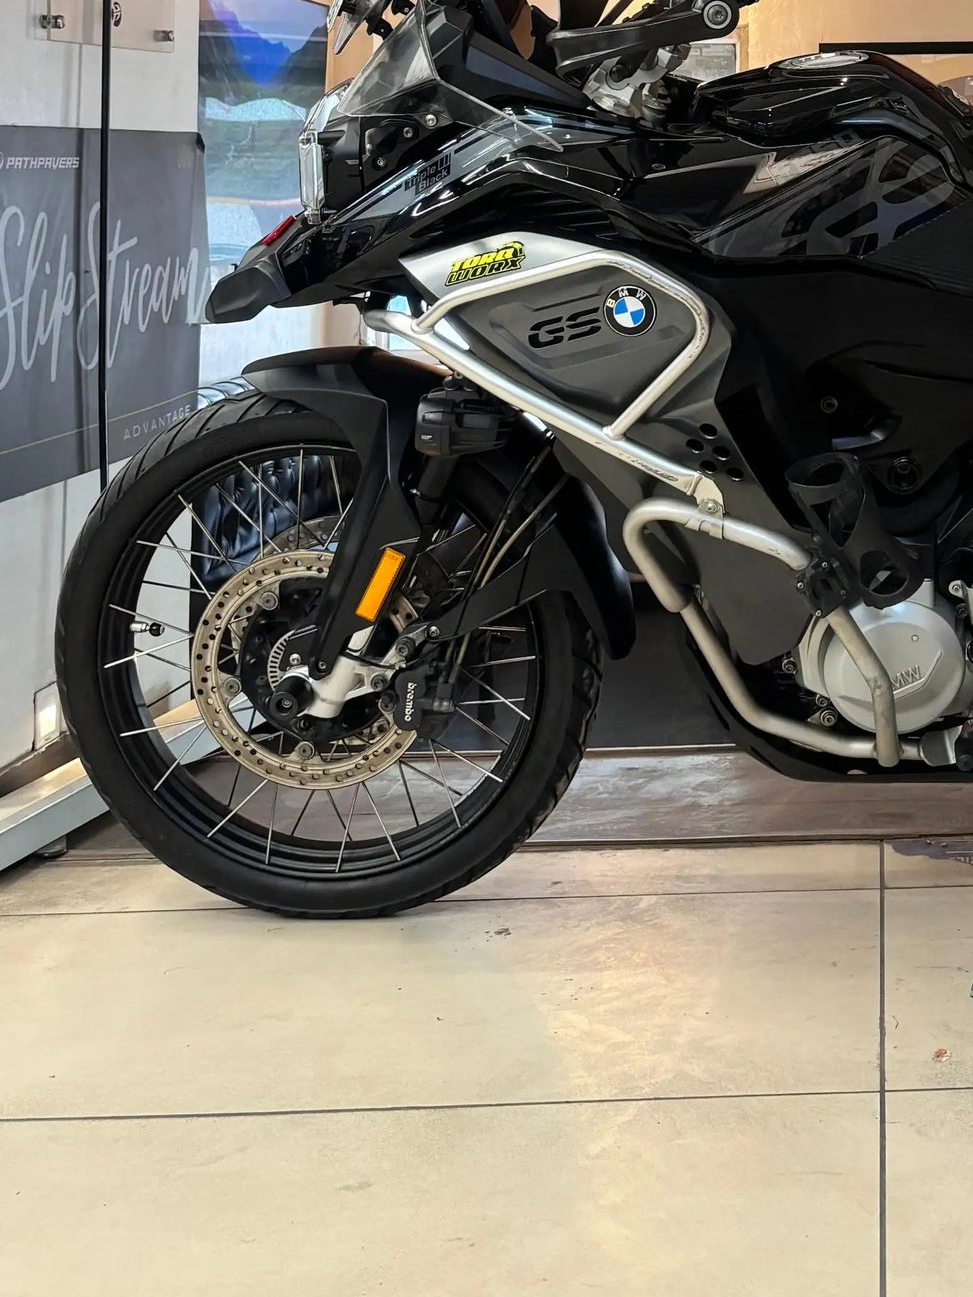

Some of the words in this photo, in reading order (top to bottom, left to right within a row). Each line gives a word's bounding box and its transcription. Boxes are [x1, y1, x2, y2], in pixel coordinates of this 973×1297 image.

[6, 156, 80, 170] PATHPAVERS
[406, 165, 437, 188] Triple
[419, 169, 448, 192] Black
[445, 255, 526, 286] WORX
[606, 287, 647, 308] BMW
[528, 307, 602, 349] GS
[123, 404, 191, 441] ADVANTAGE
[404, 682, 418, 722] brembo
